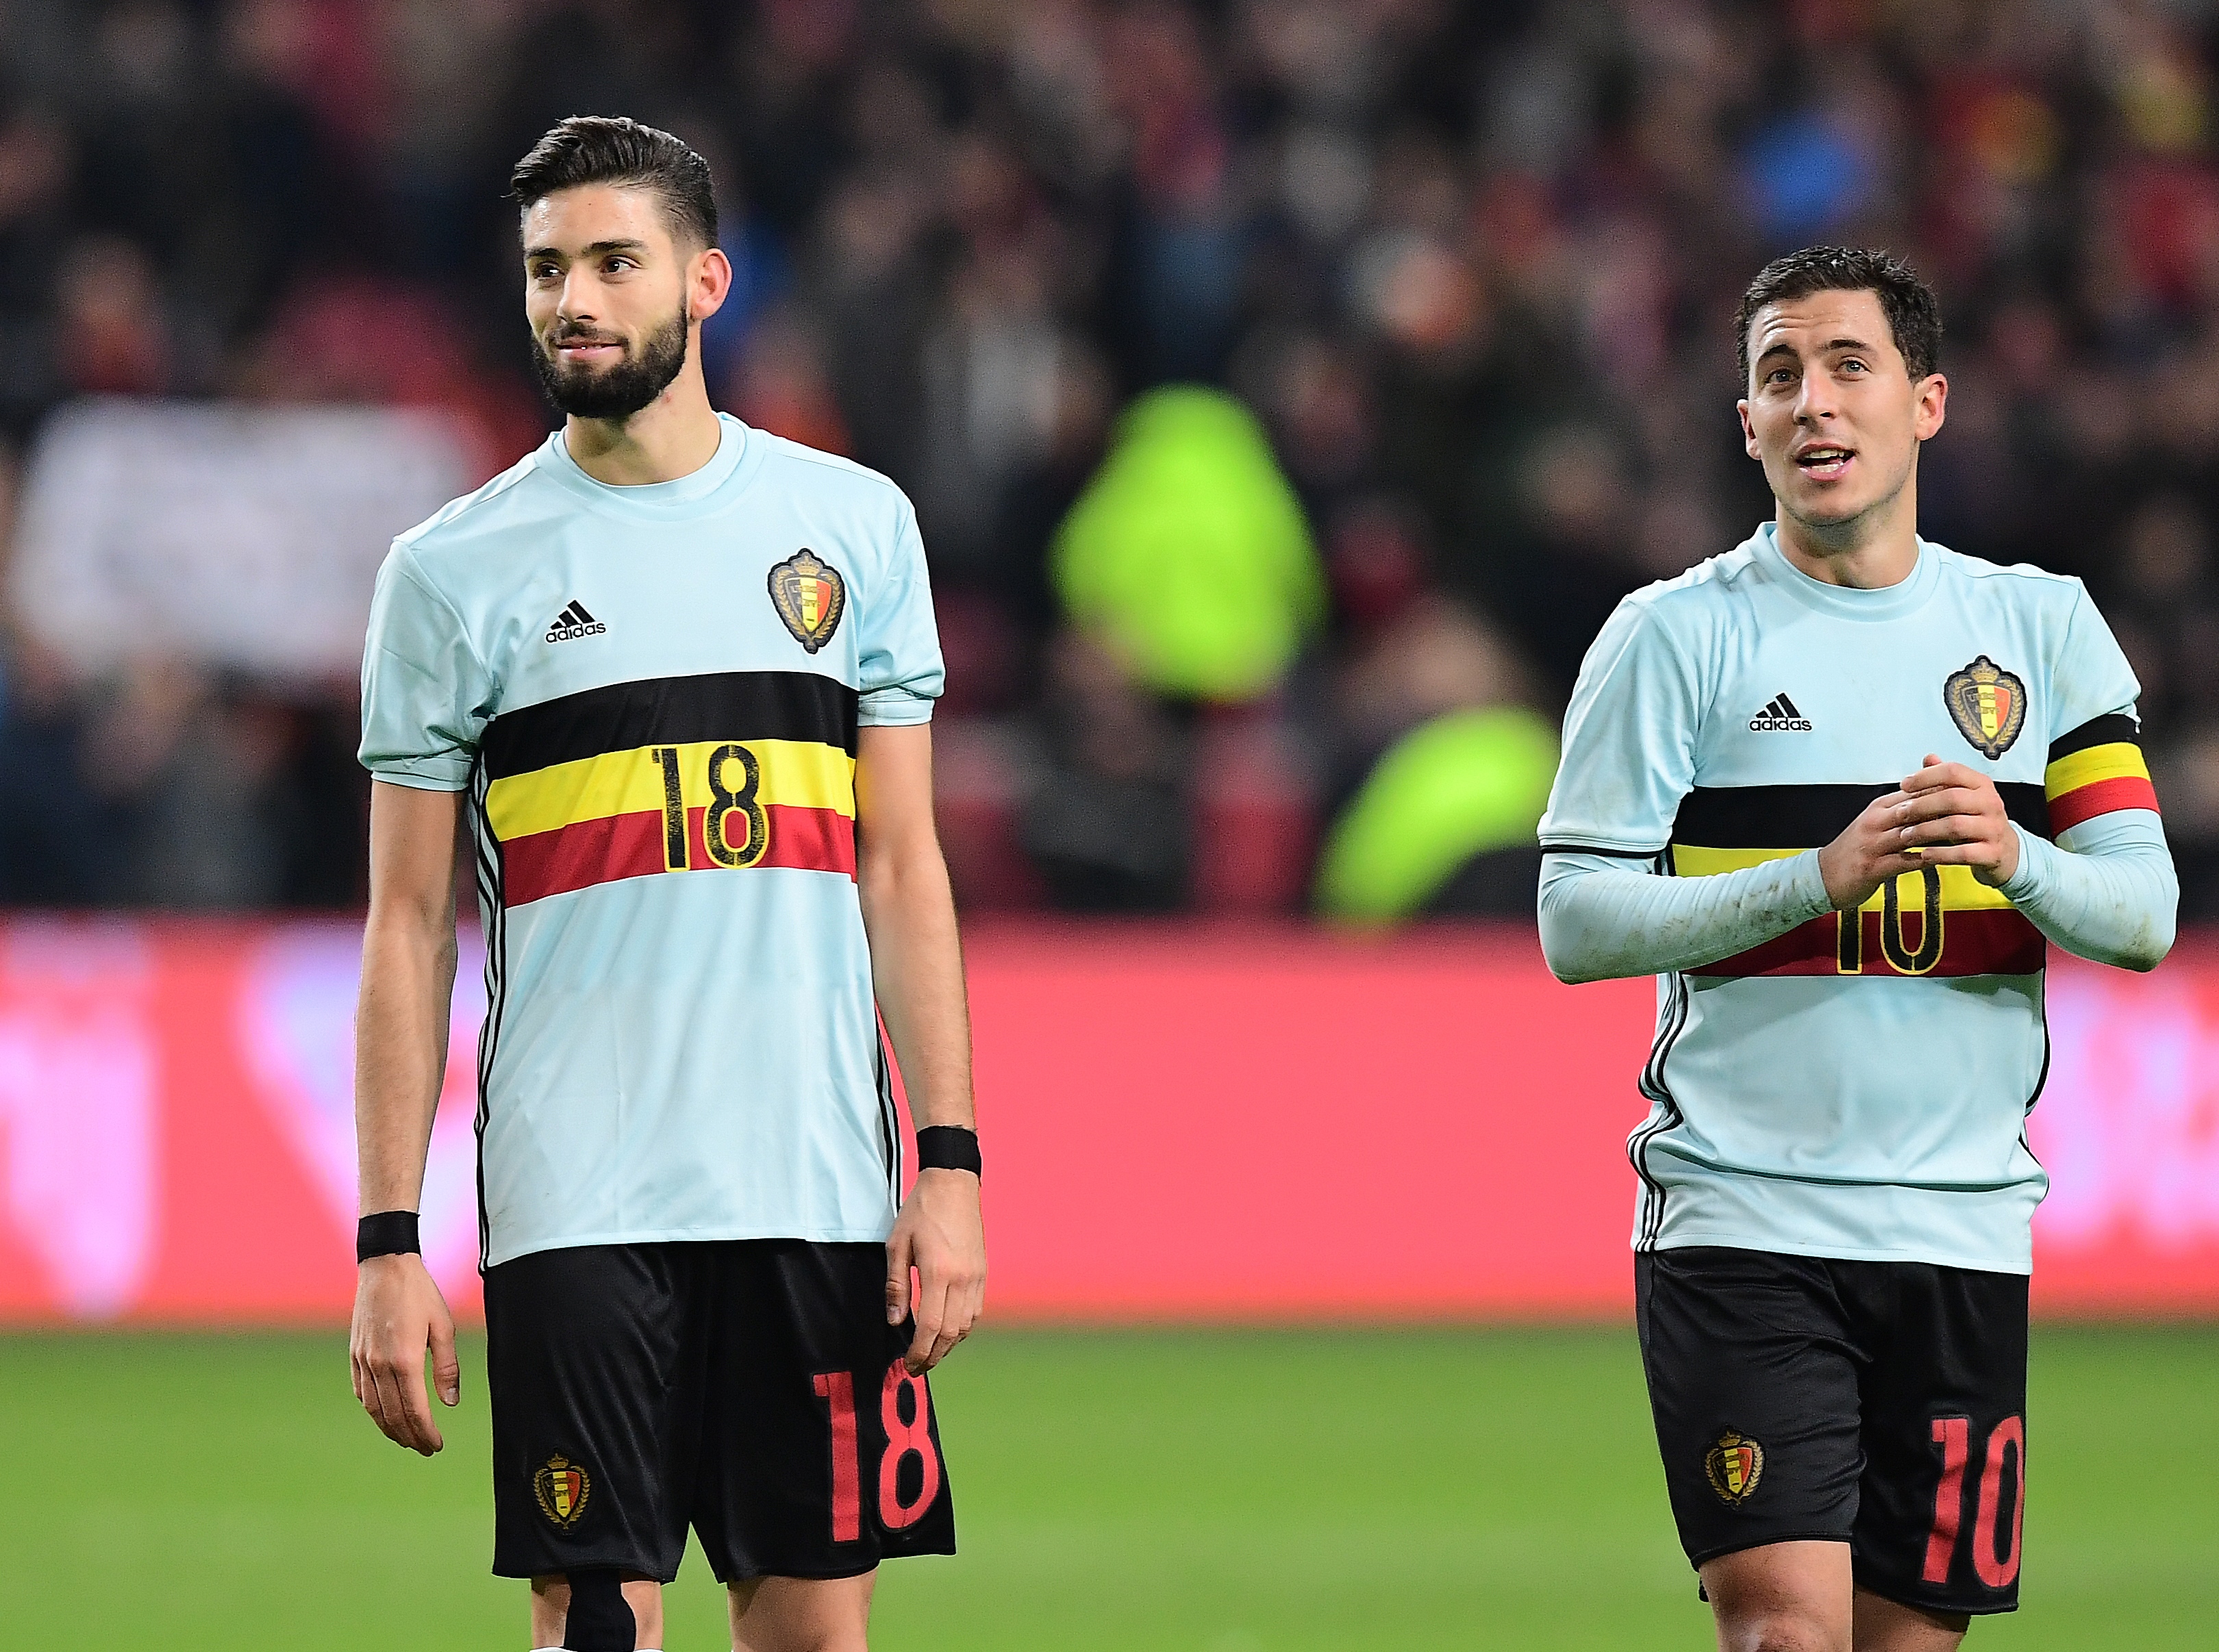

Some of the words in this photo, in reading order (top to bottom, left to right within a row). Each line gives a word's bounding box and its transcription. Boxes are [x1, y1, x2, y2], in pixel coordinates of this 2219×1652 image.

[546, 623, 606, 643] adidas
[1749, 717, 1812, 731] adidas
[651, 743, 770, 873] 18
[813, 1357, 939, 1542] 18
[1922, 1416, 2024, 1588] 10
